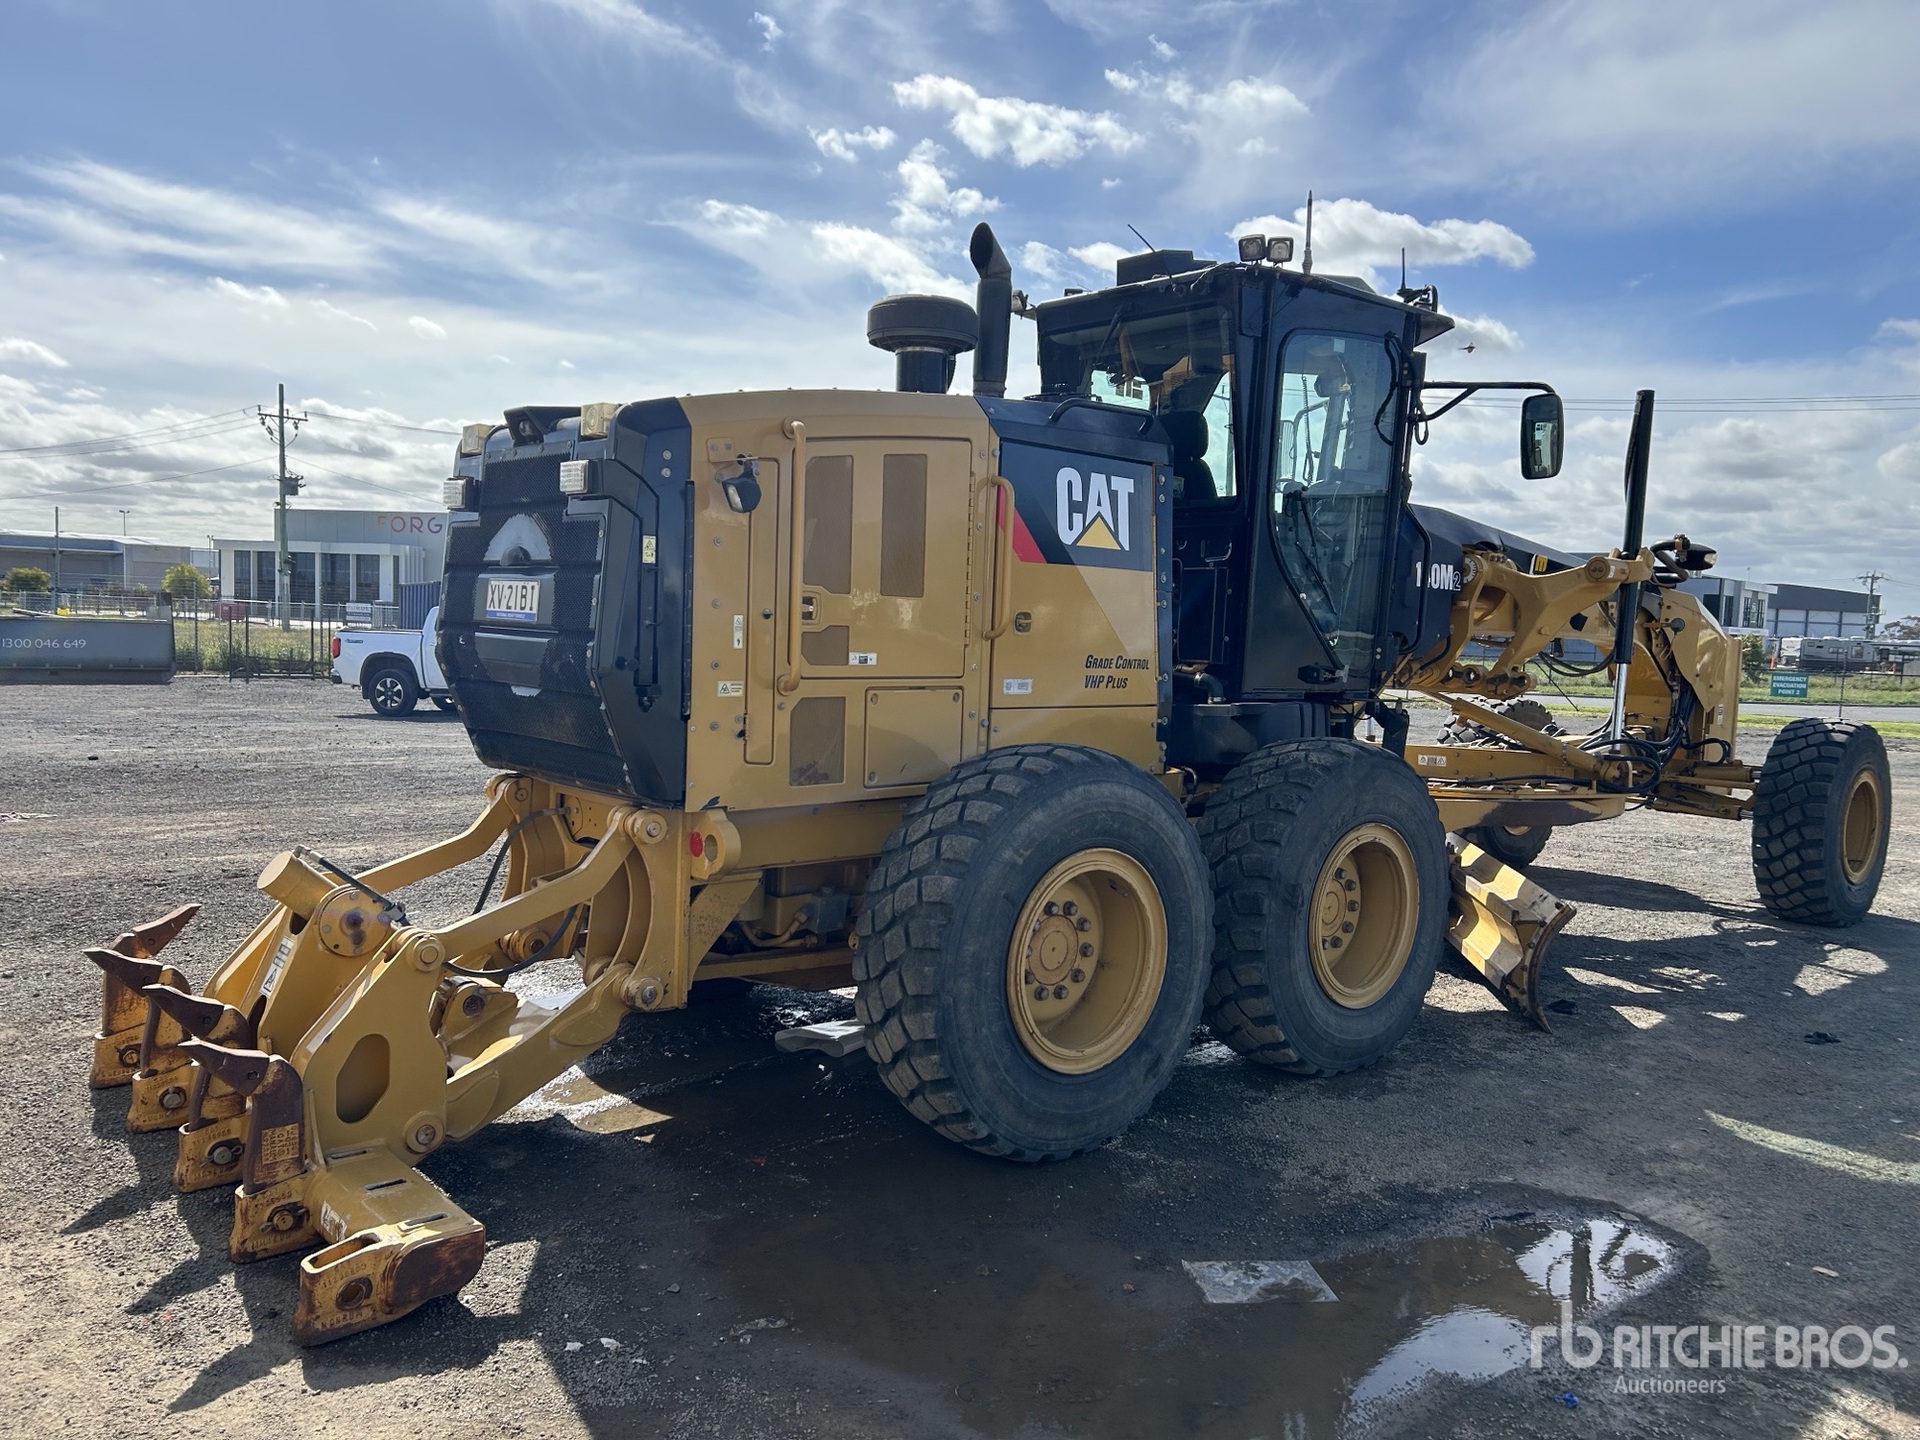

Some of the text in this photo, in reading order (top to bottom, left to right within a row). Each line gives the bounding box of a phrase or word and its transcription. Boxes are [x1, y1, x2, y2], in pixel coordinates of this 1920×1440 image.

[1056, 467, 1135, 551] CAT
[1415, 561, 1461, 591] 10M2
[2, 638, 87, 649] 1300 046 649
[1084, 675, 1105, 689] VHP
